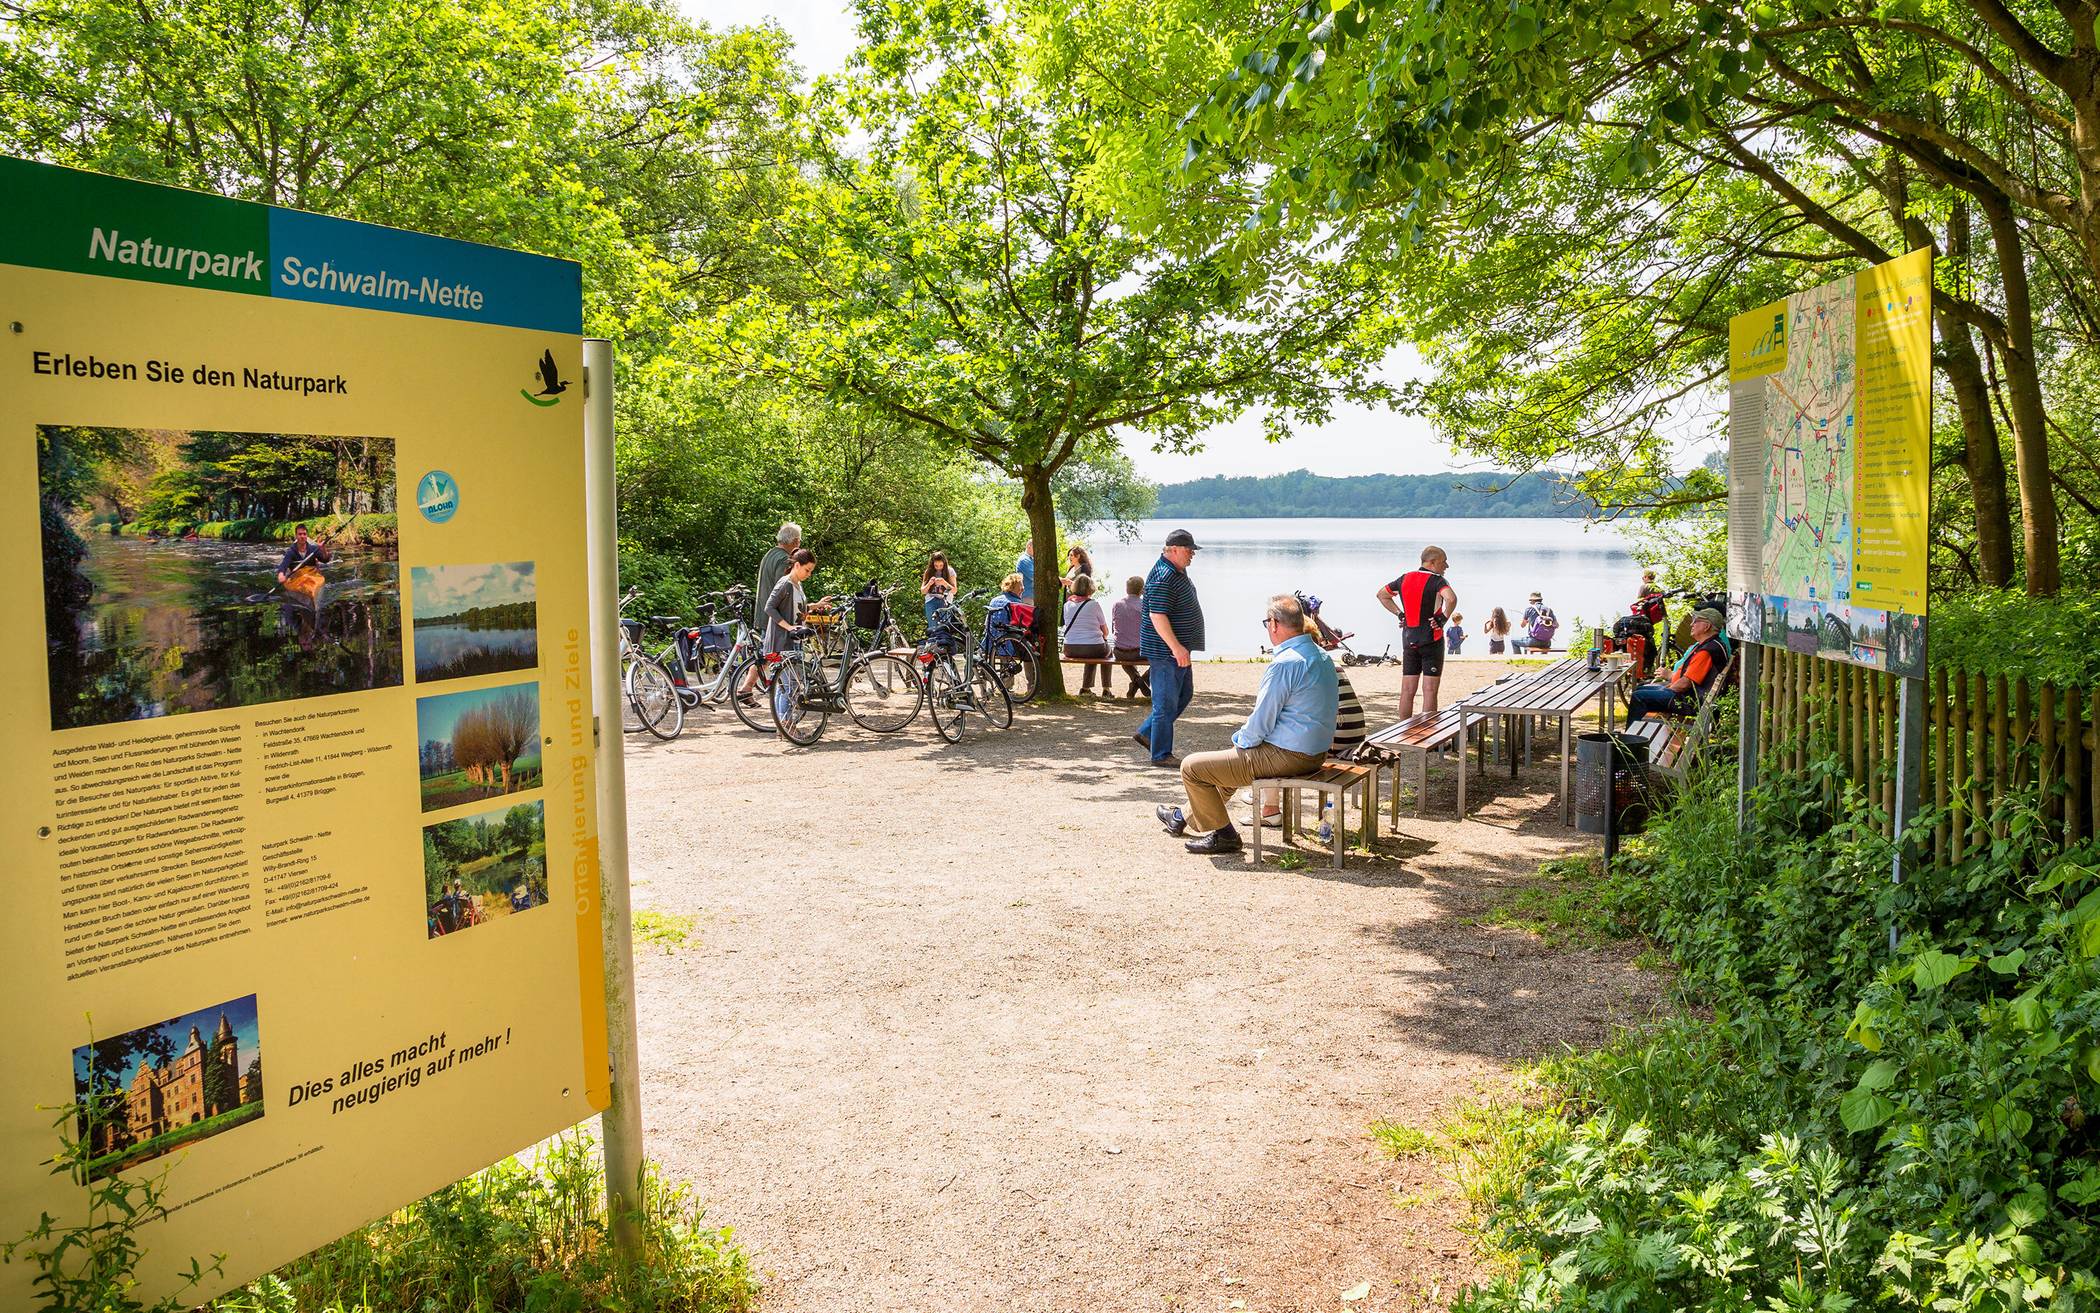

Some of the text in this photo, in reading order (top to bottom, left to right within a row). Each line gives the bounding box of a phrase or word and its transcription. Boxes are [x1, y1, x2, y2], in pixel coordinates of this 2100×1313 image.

[88, 226, 485, 311] Naturpark Schwalm-Nette
[32, 350, 347, 396] Erleben Sie den Naturpark
[564, 627, 591, 917] Orientierung und Ziele
[288, 1030, 446, 1108] Dies alles macht
[331, 1027, 511, 1115] neugierig auf mehr !
